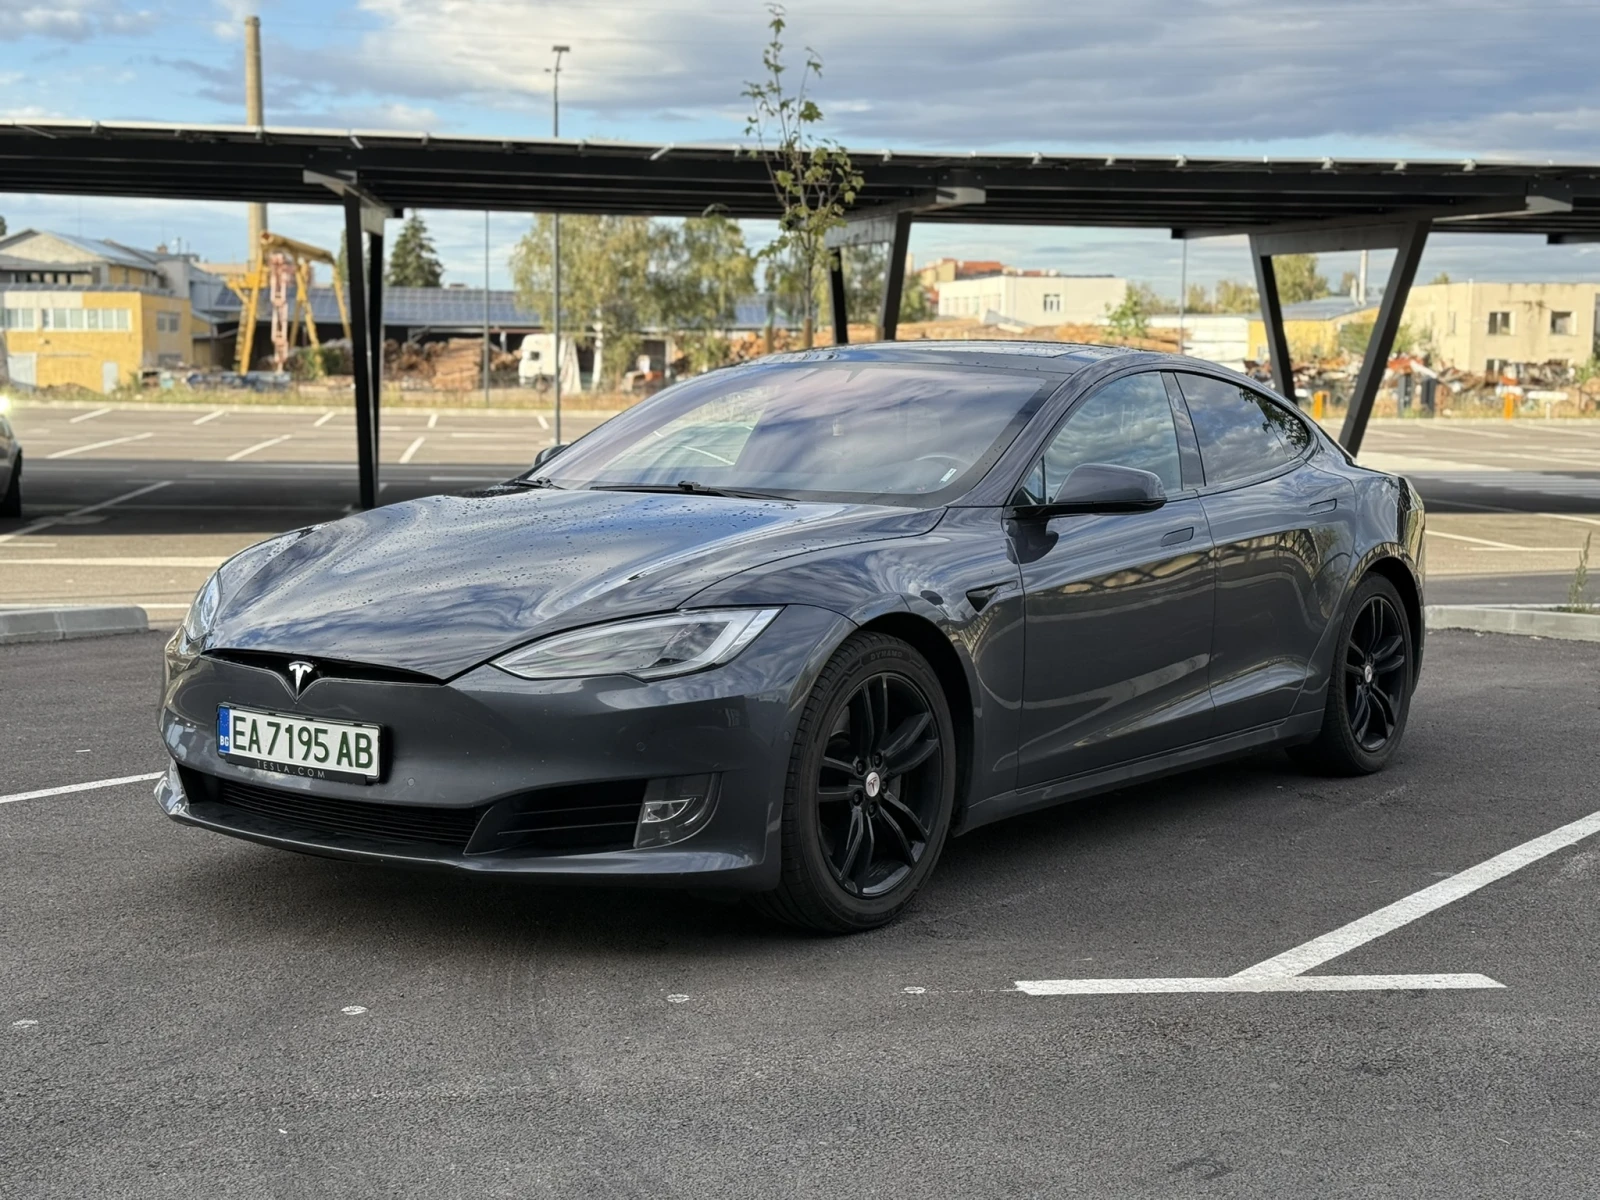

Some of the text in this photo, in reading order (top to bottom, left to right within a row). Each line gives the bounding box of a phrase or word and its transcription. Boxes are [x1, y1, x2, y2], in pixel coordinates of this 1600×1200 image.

[870, 649, 903, 661] DYNAMO
[220, 735, 230, 747] BG
[336, 731, 373, 769] AB
[256, 760, 326, 779] TESLA.COM
